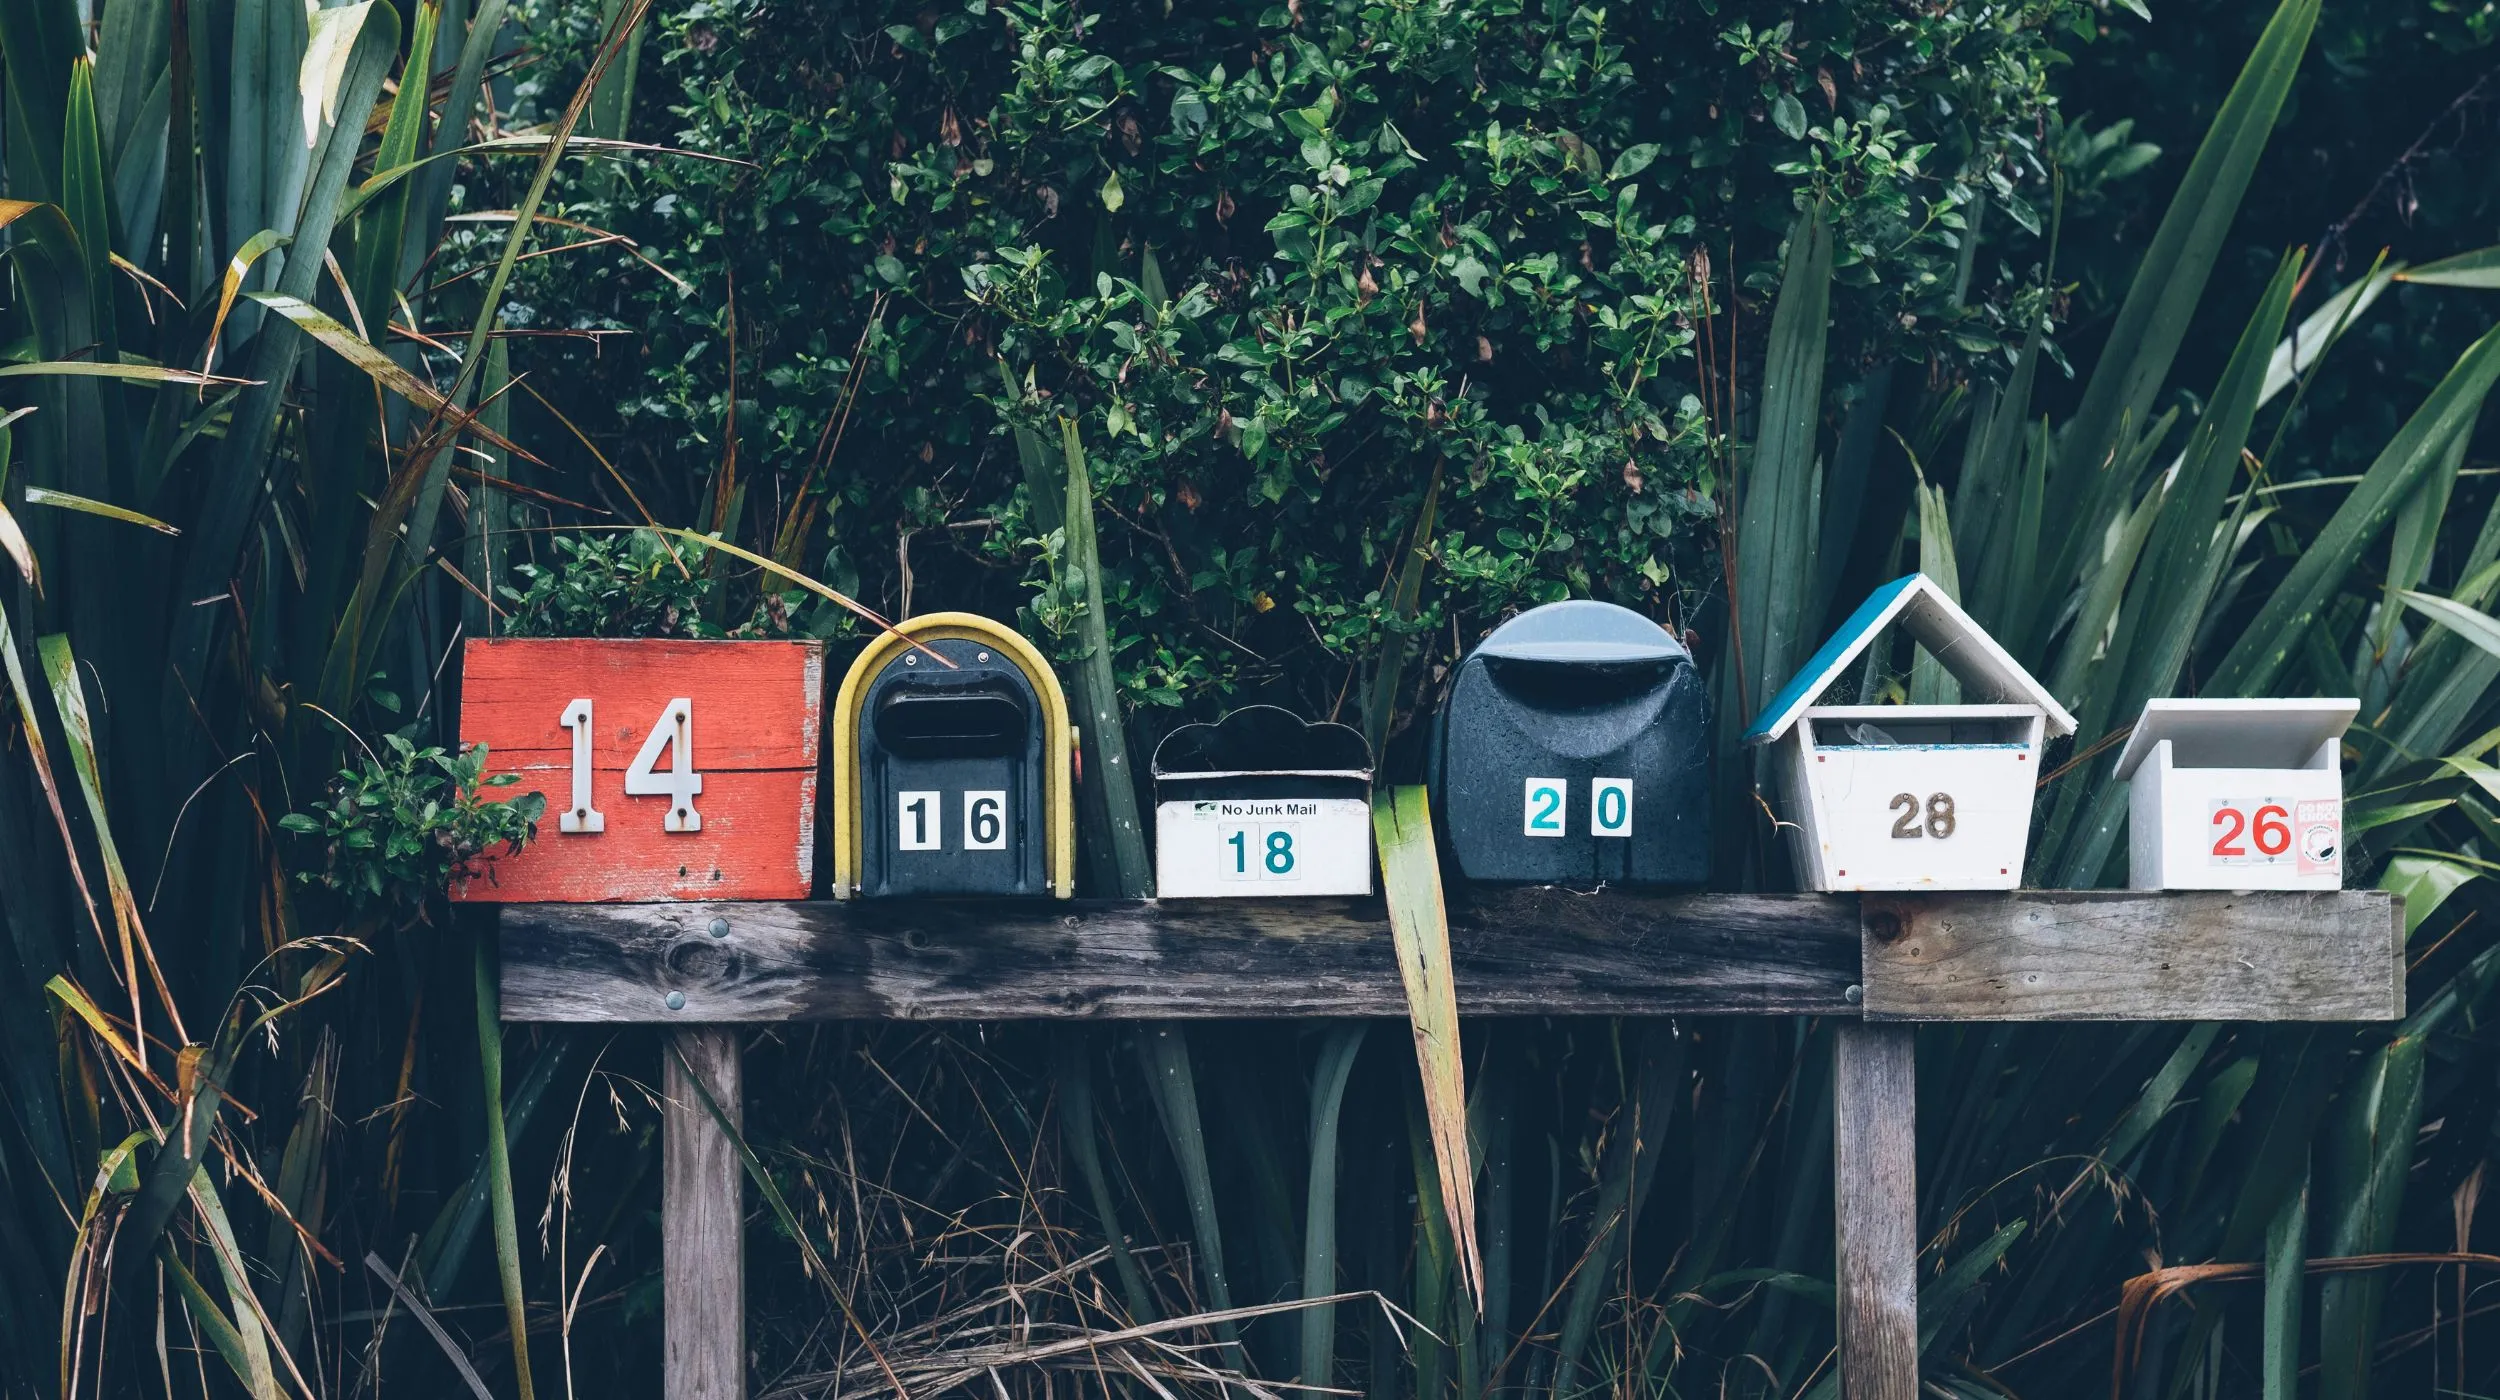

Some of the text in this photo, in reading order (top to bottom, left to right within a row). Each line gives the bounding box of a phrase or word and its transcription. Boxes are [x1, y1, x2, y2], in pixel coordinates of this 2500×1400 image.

[560, 698, 702, 833] 14
[906, 798, 1000, 844] 16
[1222, 803, 1316, 815] No Junk Mail
[1530, 787, 1627, 829] 20
[1889, 792, 1956, 839] 28
[2212, 805, 2292, 856] 26
[1228, 830, 1295, 874] 18
